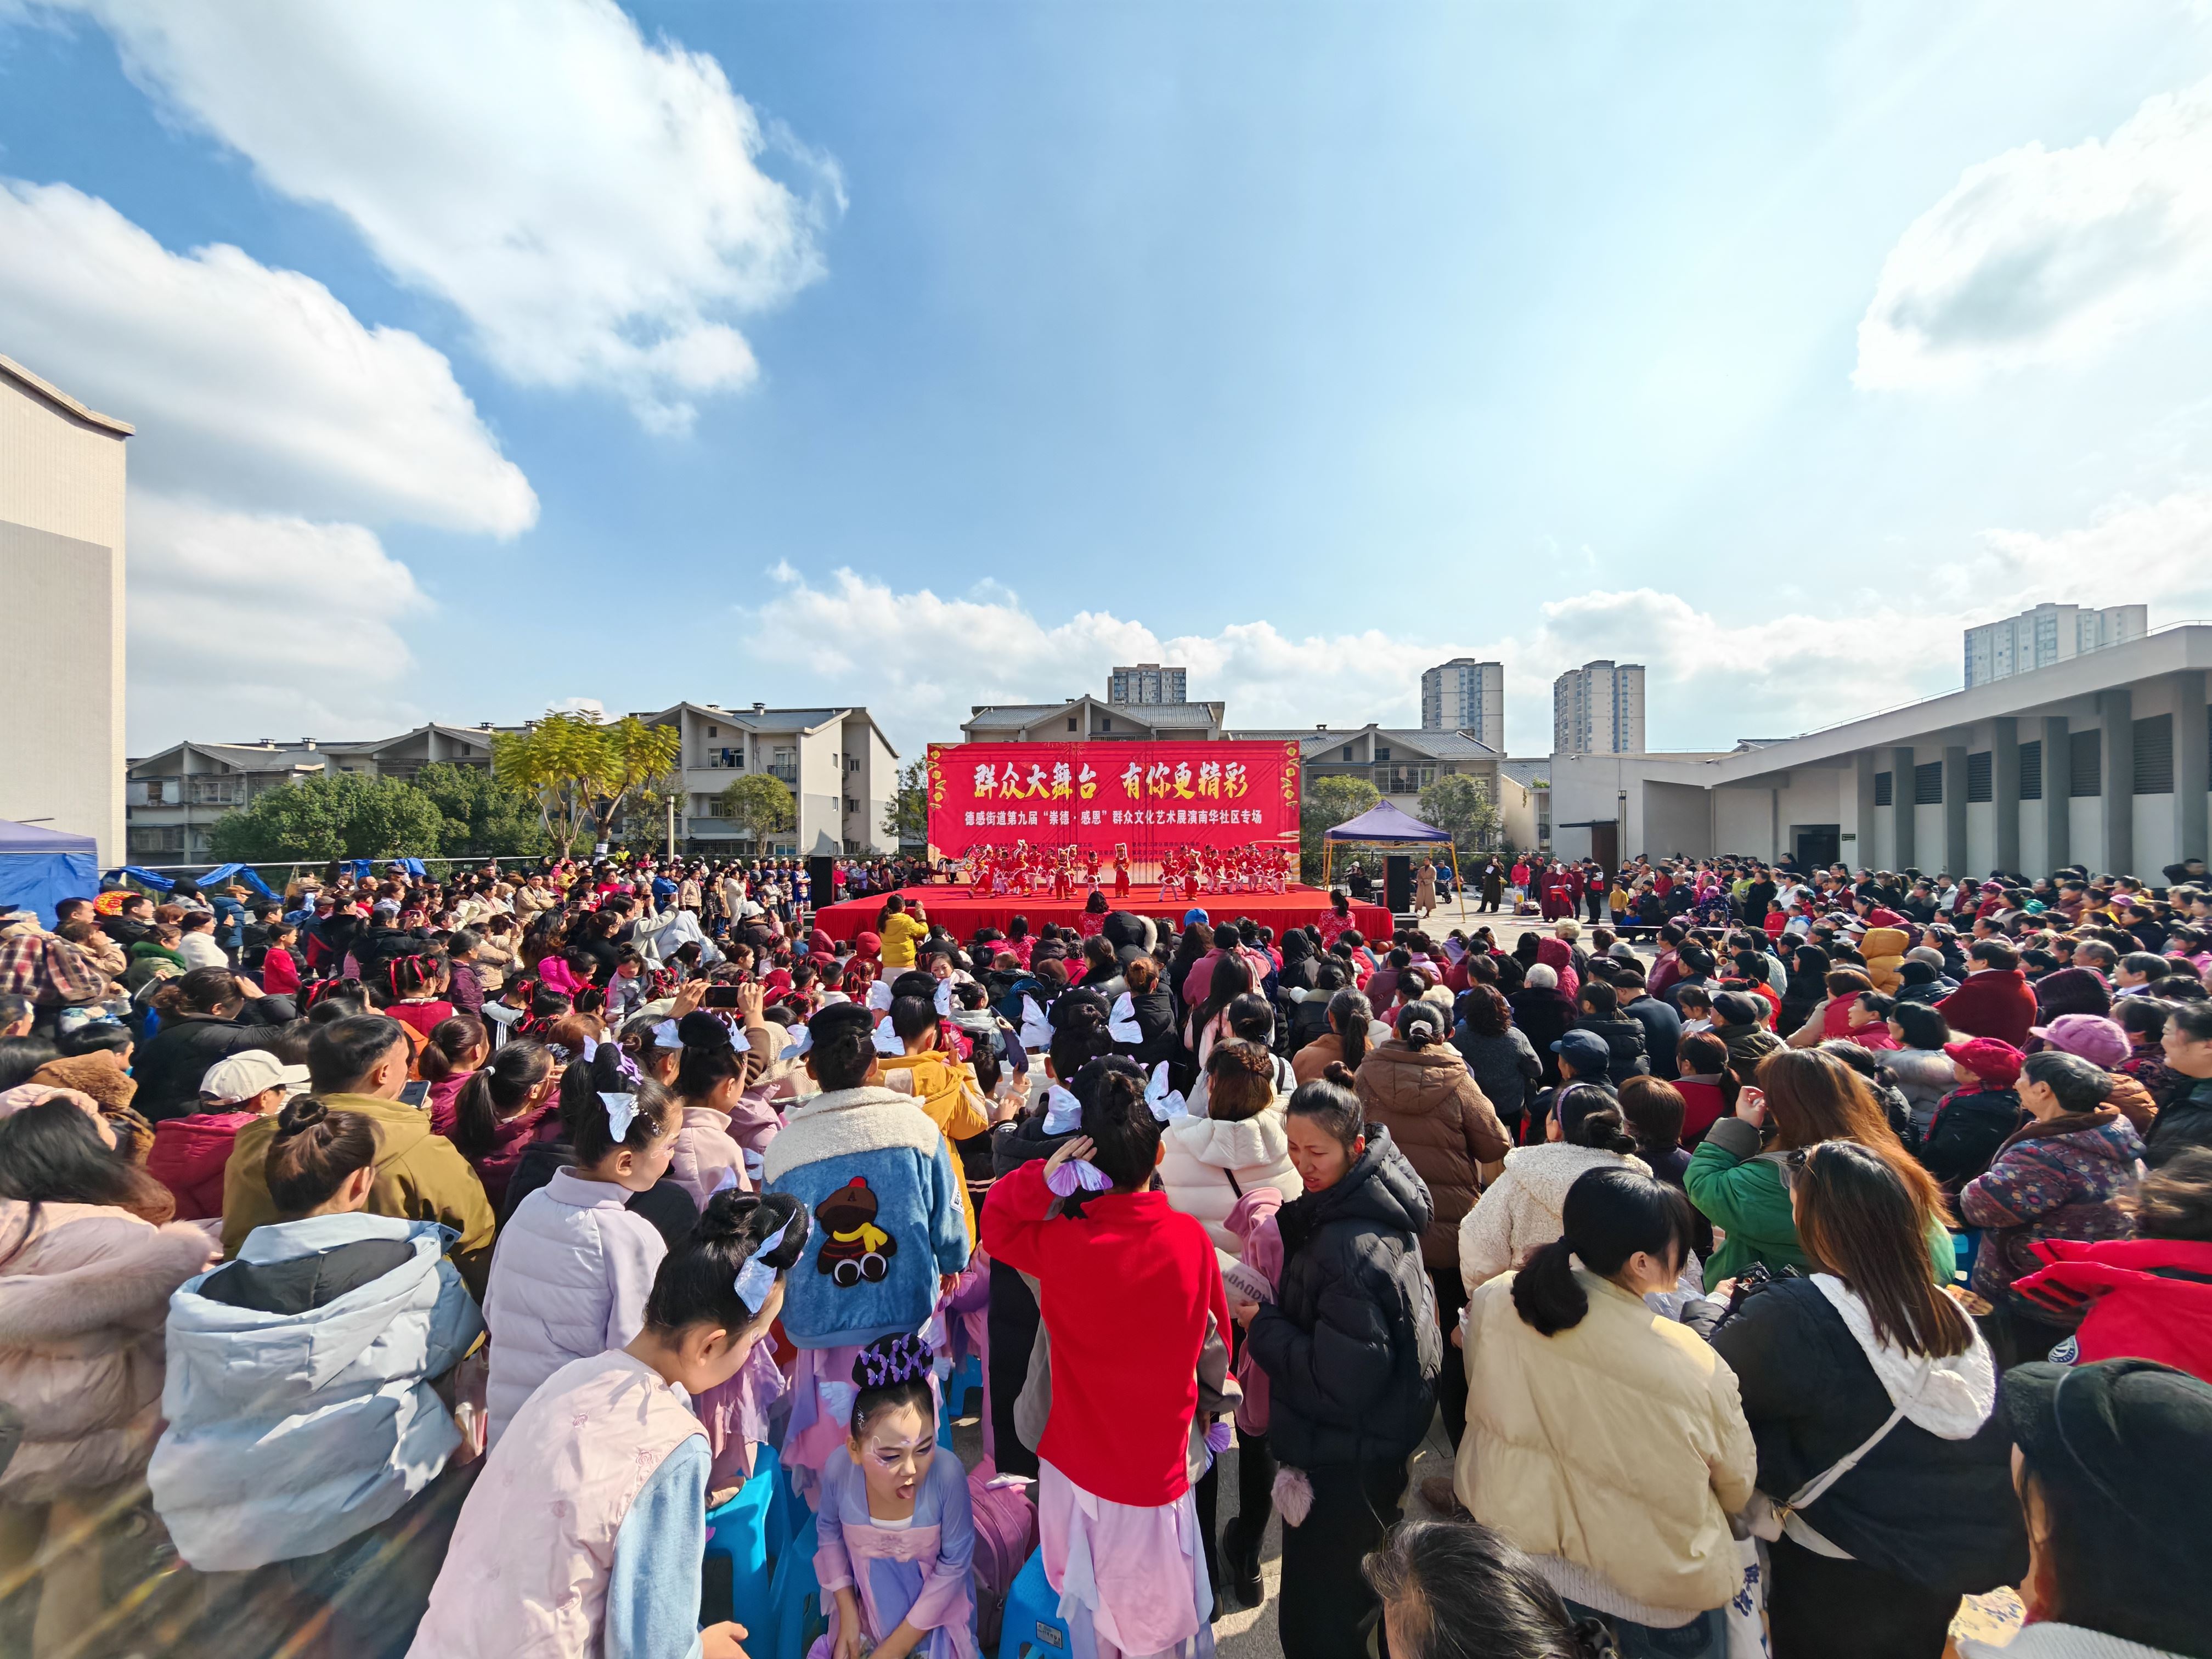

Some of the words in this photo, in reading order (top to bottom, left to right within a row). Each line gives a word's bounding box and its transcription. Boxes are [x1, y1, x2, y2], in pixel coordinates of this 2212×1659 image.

[974, 761, 1096, 800] 群众大舞台
[1120, 761, 1248, 799] 有你更精彩
